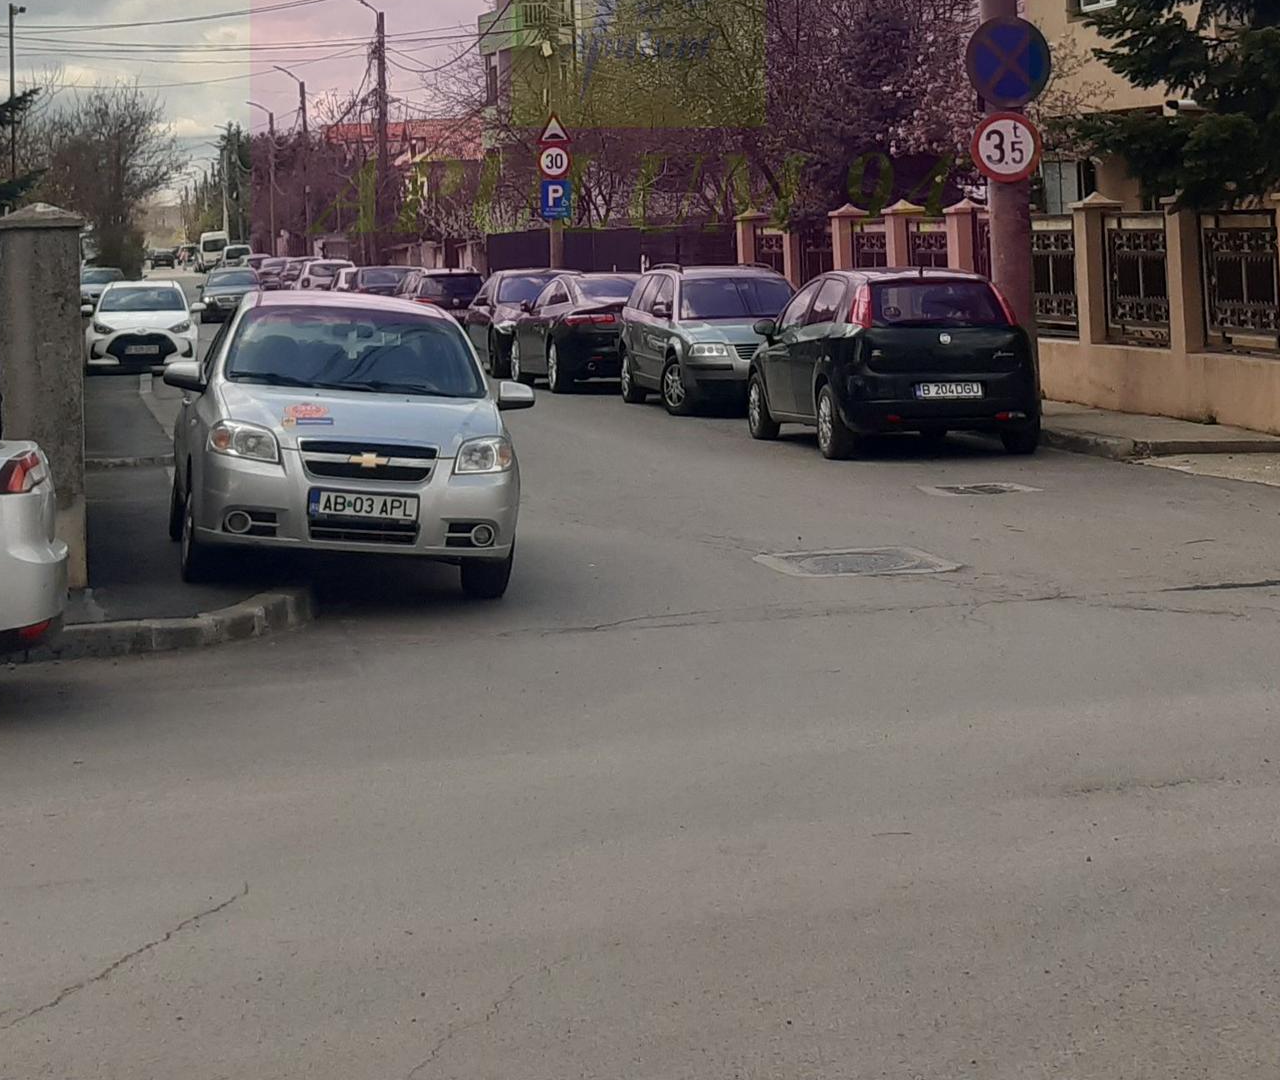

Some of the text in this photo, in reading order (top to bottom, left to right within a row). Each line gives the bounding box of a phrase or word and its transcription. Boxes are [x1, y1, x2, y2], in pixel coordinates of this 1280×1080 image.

[1013, 122, 1021, 138] t
[985, 129, 1024, 166] 3.5
[545, 153, 563, 169] 30
[548, 185, 563, 206] P
[922, 384, 930, 395] B
[322, 495, 347, 512] AB
[353, 497, 374, 514] 03
[379, 499, 412, 517] APL
